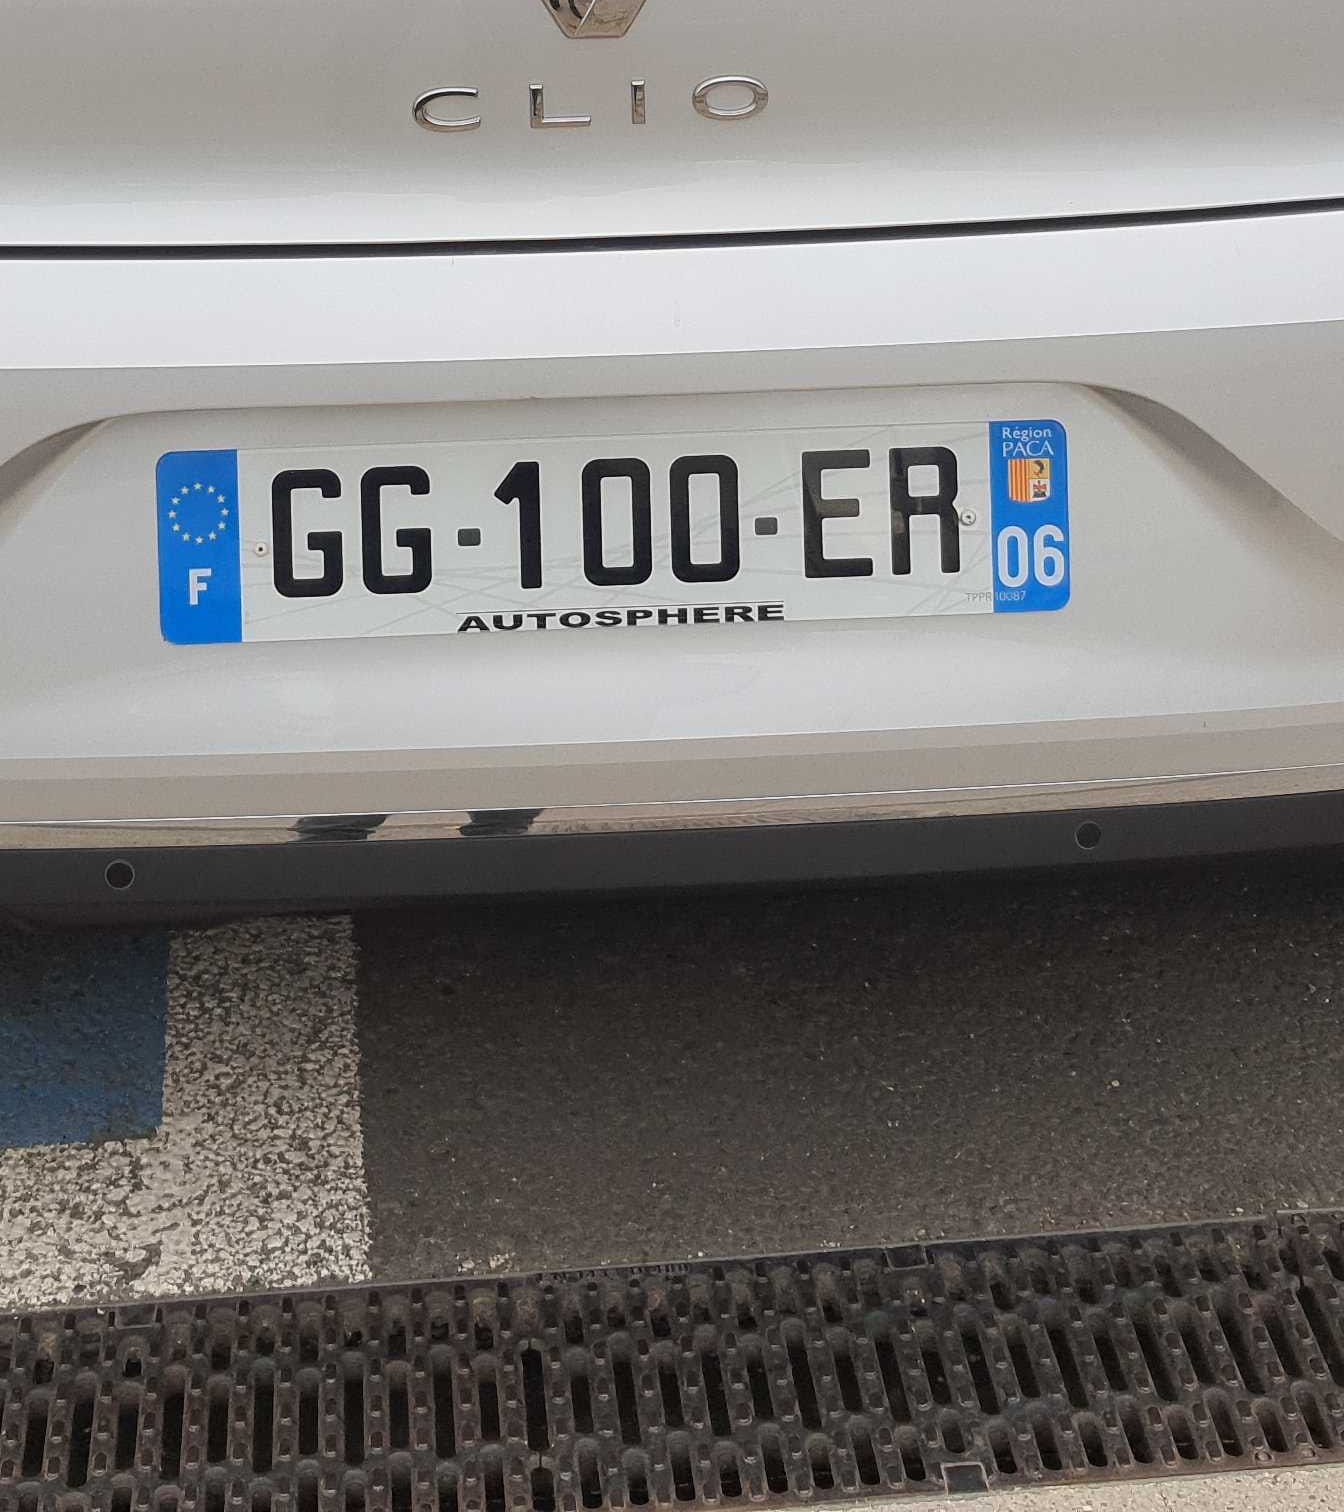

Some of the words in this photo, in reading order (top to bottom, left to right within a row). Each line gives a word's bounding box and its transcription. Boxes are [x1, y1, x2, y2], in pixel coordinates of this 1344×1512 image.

[412, 74, 769, 133] CLIO
[1002, 426, 1052, 442] Région
[1002, 440, 1055, 457] PACA
[271, 446, 961, 598] GG-100-ER
[997, 524, 1065, 588] 06
[189, 568, 212, 606] F
[457, 604, 784, 632] AUTOSPHERE
